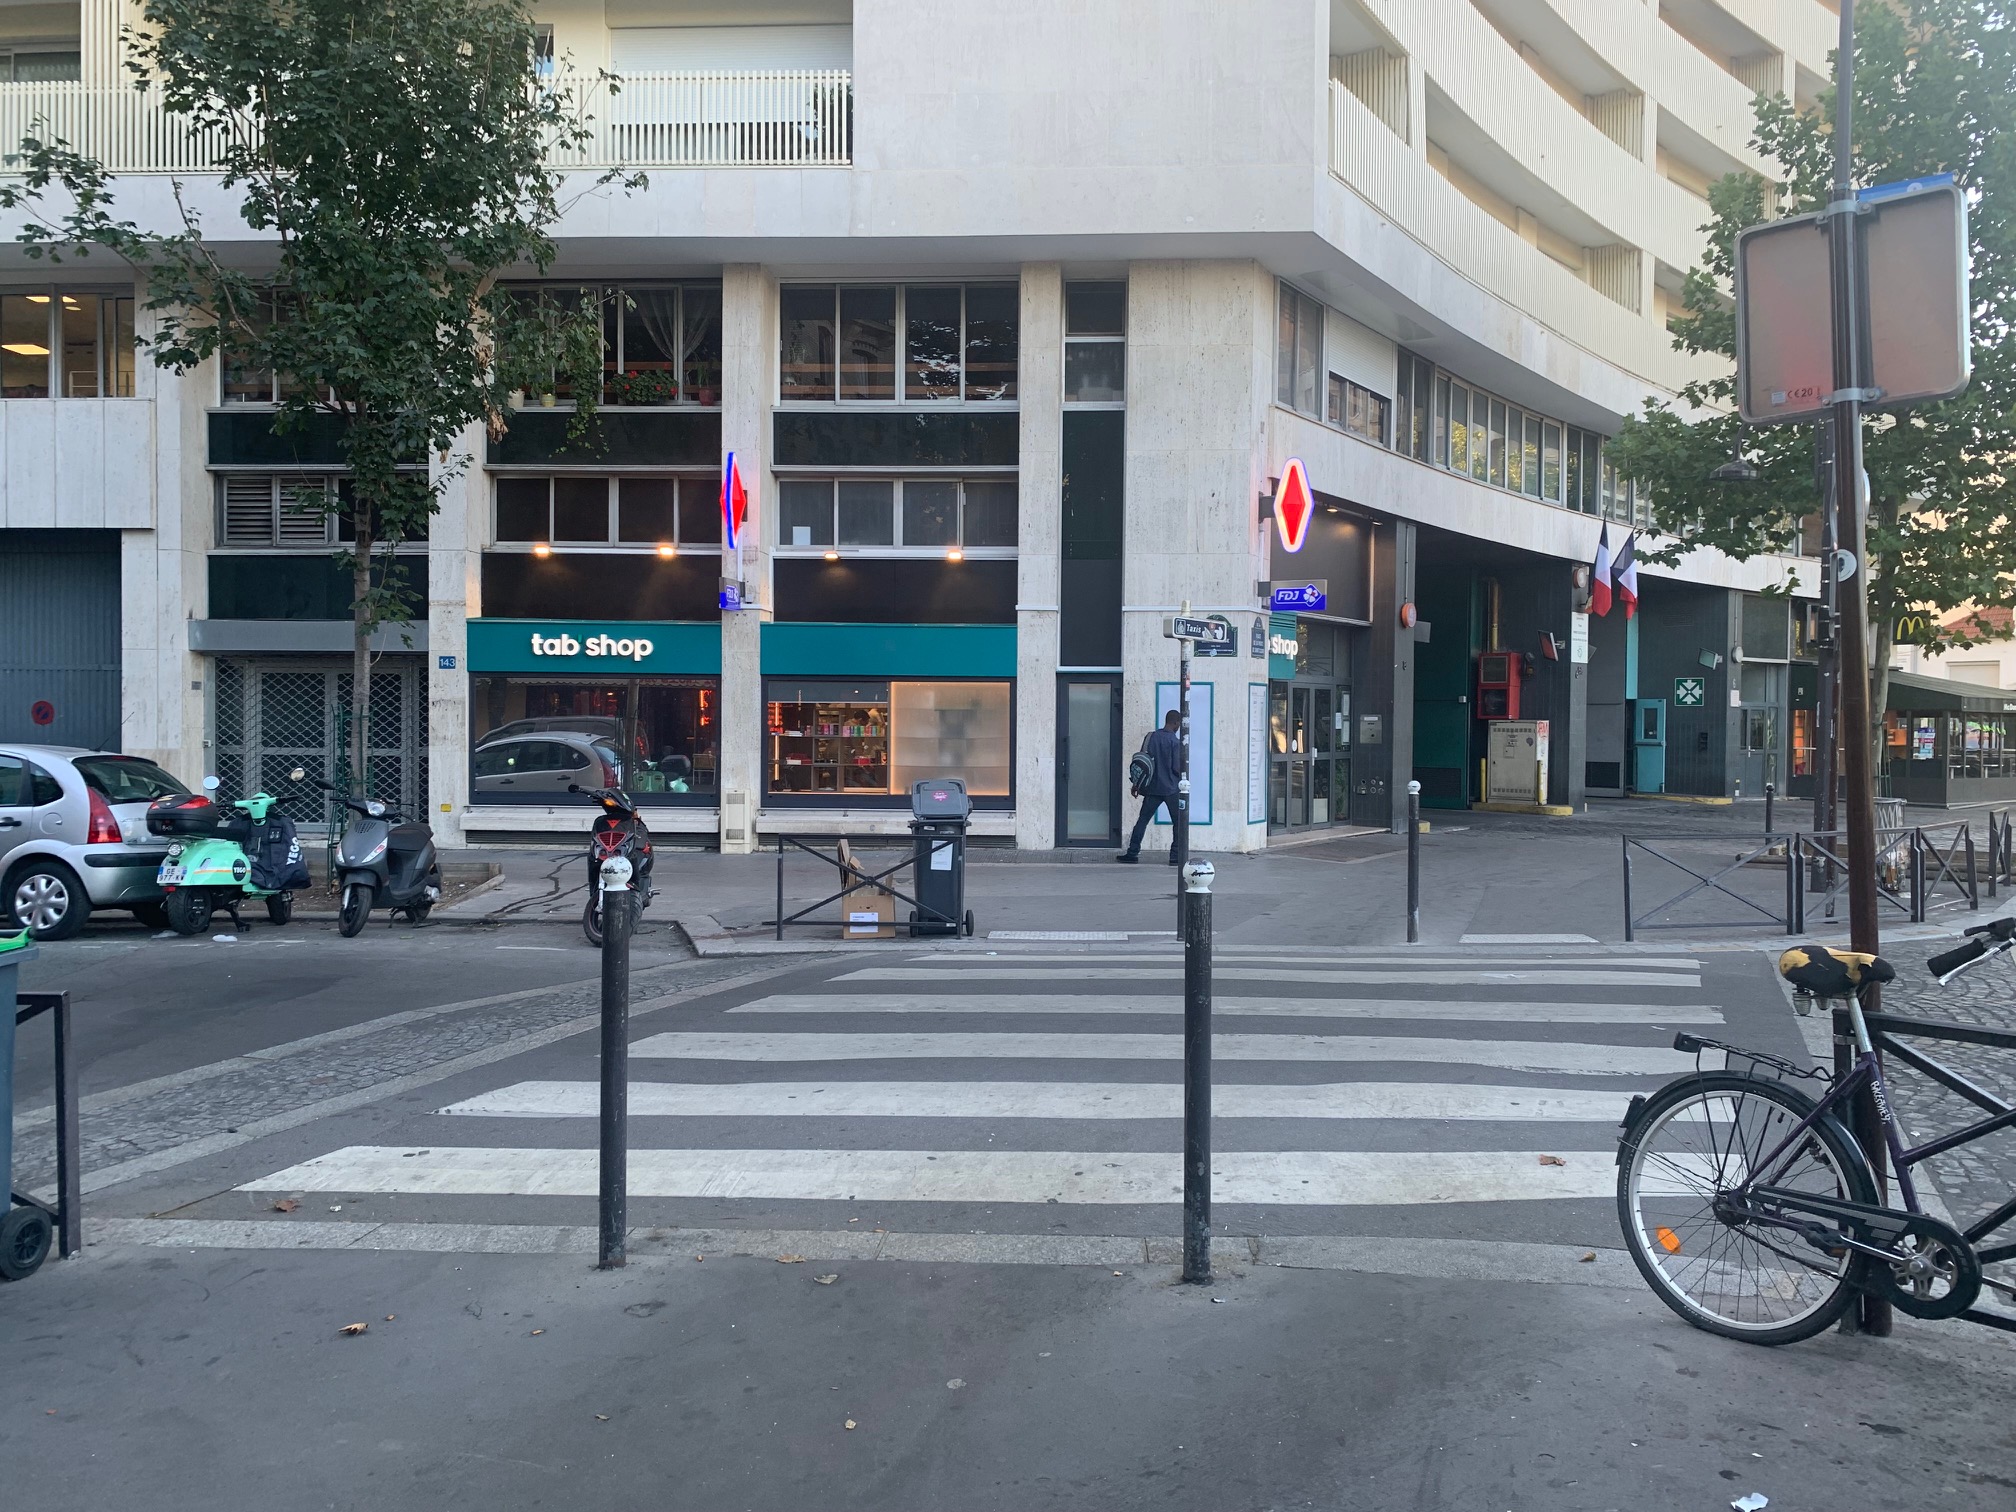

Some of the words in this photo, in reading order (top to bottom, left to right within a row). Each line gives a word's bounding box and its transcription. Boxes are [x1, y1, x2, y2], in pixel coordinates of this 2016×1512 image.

[1277, 590, 1300, 601] FDJ
[1186, 623, 1202, 634] Taxis
[439, 658, 456, 667] 143
